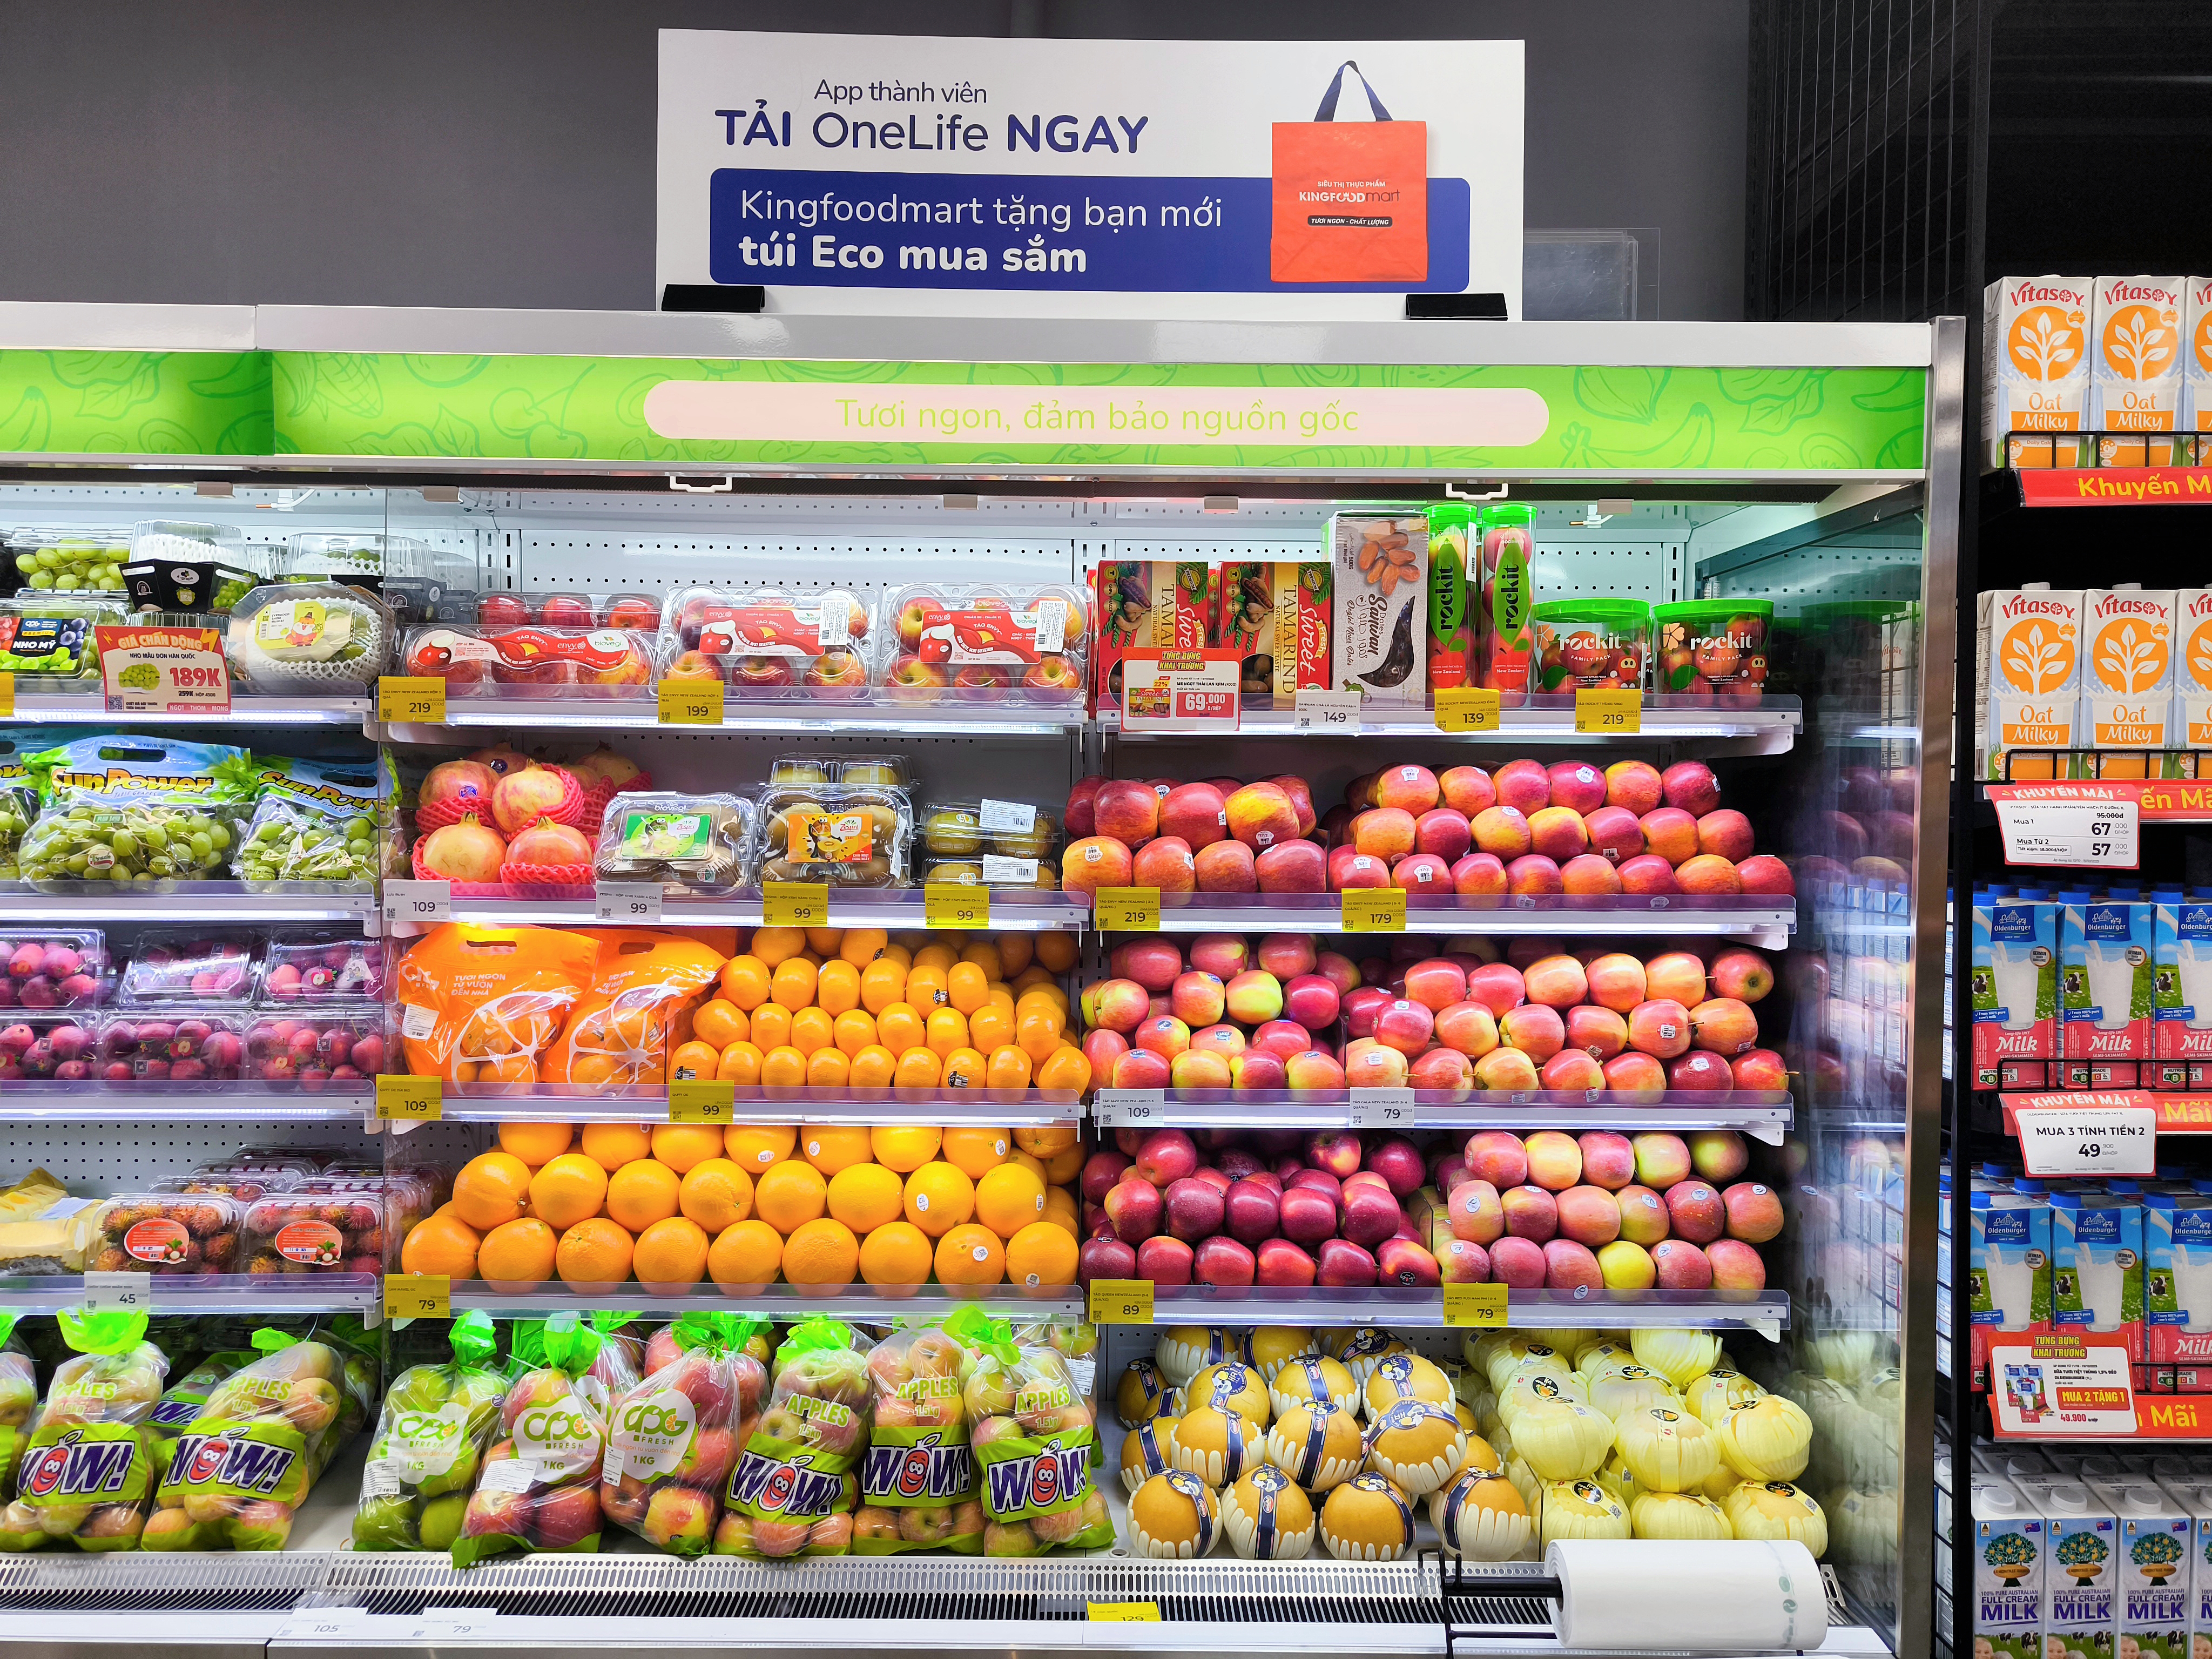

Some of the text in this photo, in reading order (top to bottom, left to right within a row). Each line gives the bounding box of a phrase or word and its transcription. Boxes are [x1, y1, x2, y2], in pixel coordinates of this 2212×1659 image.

[814, 79, 987, 104] App thành viên
[714, 99, 1149, 153] TẢI OneLife NGAY
[1318, 179, 1332, 187] SIÊU
[1366, 178, 1386, 187] PHẨM
[742, 190, 1221, 233] Kingfoodmart tặng bạn mới
[739, 231, 1087, 272] túi Eco mua sắm
[2028, 392, 2062, 410] Oat
[2123, 391, 2157, 410] Oat
[835, 399, 1358, 436] Tươi ngon, đảm bảo nguồn gốc
[2021, 414, 2068, 431] Milky
[2116, 413, 2162, 430] Milky
[2078, 474, 2179, 500] Khuyến
[1441, 565, 1453, 630] rockit
[1505, 564, 1519, 629] rockit
[1368, 594, 1388, 656] Sanwan
[38, 640, 56, 649] MỸ
[118, 634, 139, 650] GIÁ
[139, 631, 170, 647] CHẤN
[1283, 585, 1297, 694] TAMARIND
[1299, 604, 1318, 676] Sweet
[1596, 653, 1611, 662] PACK
[170, 667, 221, 686] 189K
[409, 703, 430, 713] 219
[686, 706, 709, 716] 199
[1324, 712, 1346, 723] 149
[1462, 713, 1484, 724] 139
[1602, 714, 1623, 725] 219
[2013, 786, 2114, 800] KHUYẾN MÃI
[2091, 822, 2112, 835] 67
[2092, 843, 2112, 856] 57
[413, 901, 435, 912] 109
[630, 903, 647, 913] 99
[794, 908, 811, 918] 99
[957, 911, 973, 920] 99
[1125, 912, 1145, 922] 219
[1370, 914, 1392, 923] 179
[1994, 924, 2031, 933] Oldenburger
[2087, 923, 2126, 932] Oldenburger
[1995, 1036, 2038, 1053] Milk
[2088, 1035, 2132, 1052] Milk
[404, 1101, 427, 1111] 109
[2030, 1092, 2130, 1108] KHUYẾN MÃI
[703, 1105, 719, 1115] 99
[1128, 1108, 1150, 1117] 109
[1384, 1109, 1400, 1118] 79
[2036, 1124, 2145, 1136] MUA 3 TÍNH TIỀN 2
[2079, 1143, 2101, 1157] 49
[119, 1294, 136, 1303] 45
[419, 1300, 435, 1310] 79
[1123, 1305, 1139, 1315] 89
[1477, 1309, 1493, 1319] 79
[2033, 1348, 2052, 1357] KHAI
[896, 1378, 958, 1400] APPLES
[2062, 1390, 2125, 1405] MUA 2 TẶNG 1
[2061, 1414, 2087, 1422] 49.900
[2150, 1405, 2197, 1427] Mãi
[642, 1437, 674, 1446] FRESH
[163, 1431, 295, 1494] WOW!
[633, 1455, 655, 1465] 1 KG
[865, 1442, 972, 1498] WOW!
[1981, 1602, 2038, 1620] MILK
[2054, 1601, 2111, 1620] MILK
[2127, 1602, 2184, 1620] MILK
[313, 1624, 340, 1633] 105
